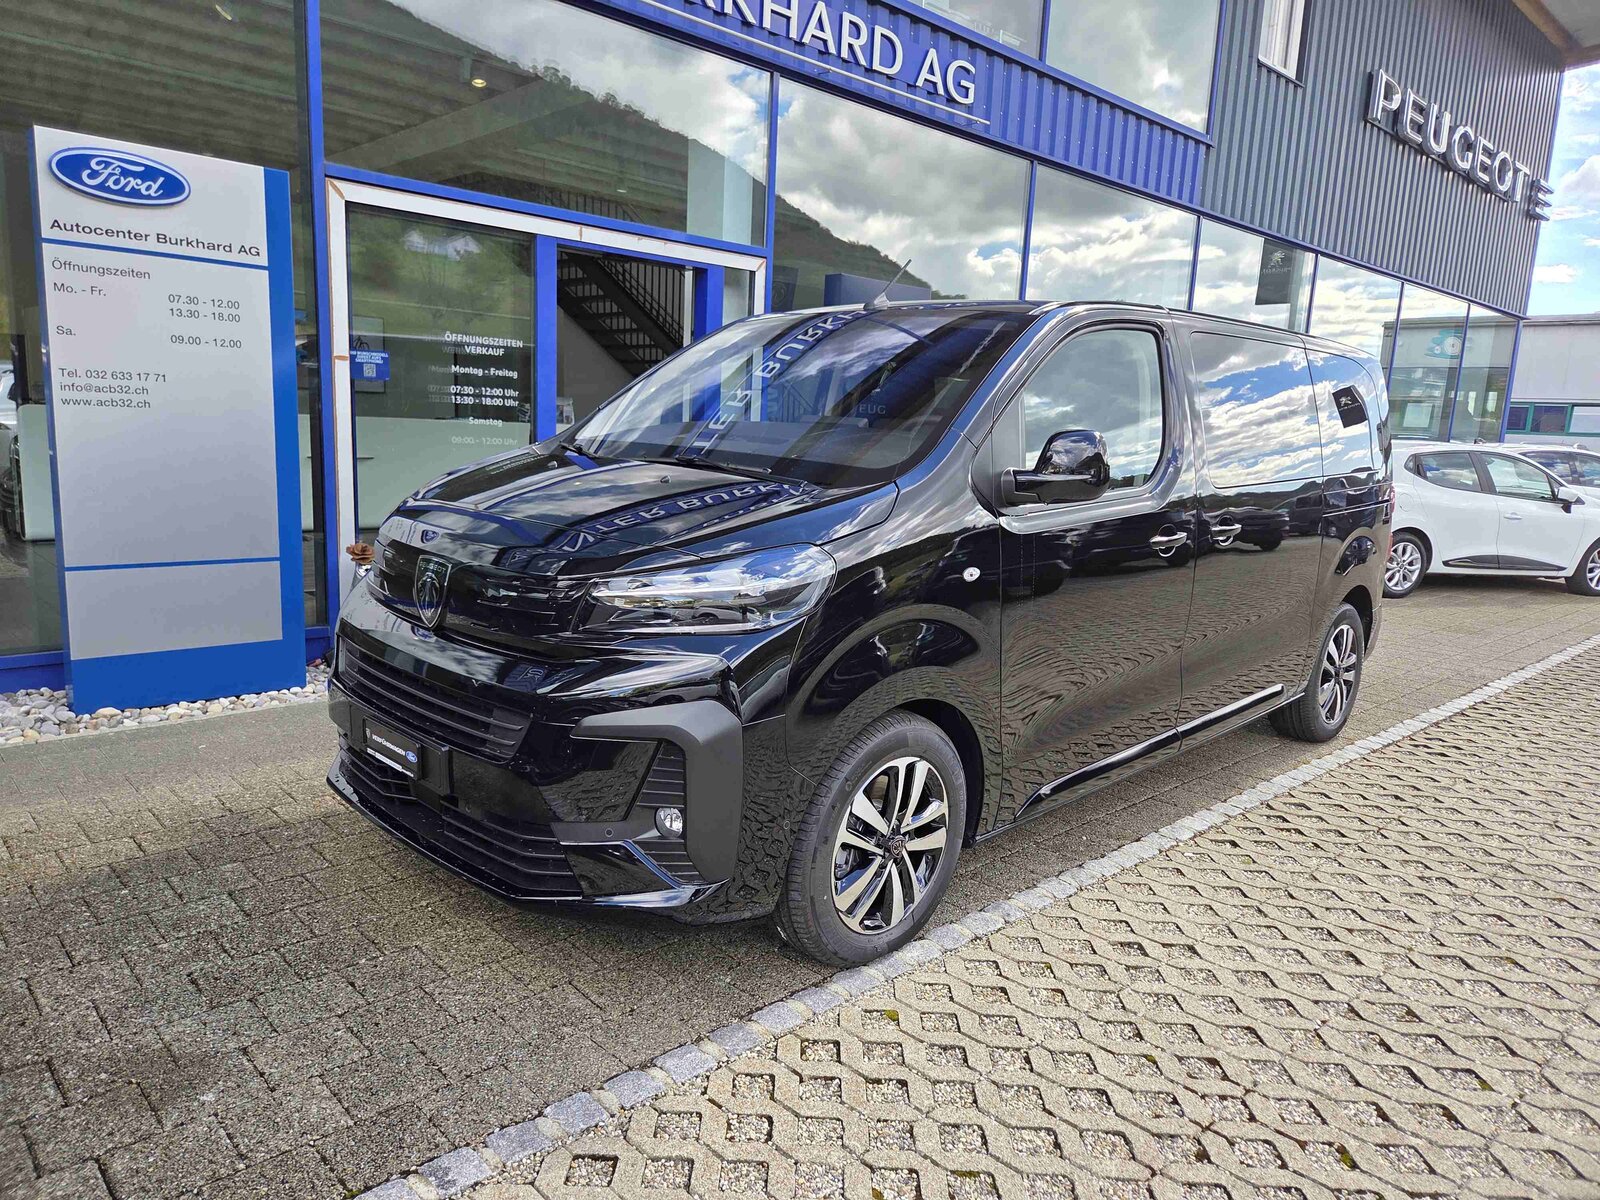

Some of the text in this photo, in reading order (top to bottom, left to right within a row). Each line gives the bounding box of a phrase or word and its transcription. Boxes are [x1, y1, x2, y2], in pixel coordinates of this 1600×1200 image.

[704, 0, 976, 104] HARD AG
[1367, 69, 1530, 203] PEUGEOT
[81, 157, 164, 197] Ford
[50, 219, 261, 257] Autocenter Burkhard AG
[51, 257, 151, 280] Öffnungszeiten
[53, 282, 78, 294] Mo.
[90, 286, 107, 297] Fr.
[168, 294, 199, 306] 07.30
[210, 299, 240, 310] 12.00
[169, 308, 200, 320] 13.30
[211, 312, 241, 323] 18.00
[56, 325, 76, 336] Sa.
[170, 335, 201, 346] 09.00
[212, 338, 242, 349] 12.00
[445, 331, 523, 348] ÖFFNUNGSZEITEN
[465, 345, 505, 356] VERKAUF
[58, 368, 167, 383] Tel. 032 633 17 71
[451, 365, 483, 376] Montag
[490, 368, 518, 379] Freitag
[59, 382, 149, 395] info@acb32.ch
[450, 385, 474, 394] 07:30
[481, 387, 503, 396] 12:00
[505, 389, 519, 397] Uhr
[61, 397, 151, 409] www.acb32.ch
[451, 395, 474, 404] 13:30
[481, 397, 503, 406] 18:00
[505, 398, 519, 407] Uhr
[469, 416, 503, 427] Samstag
[482, 437, 503, 445] 12:00
[504, 438, 518, 446] Uhr
